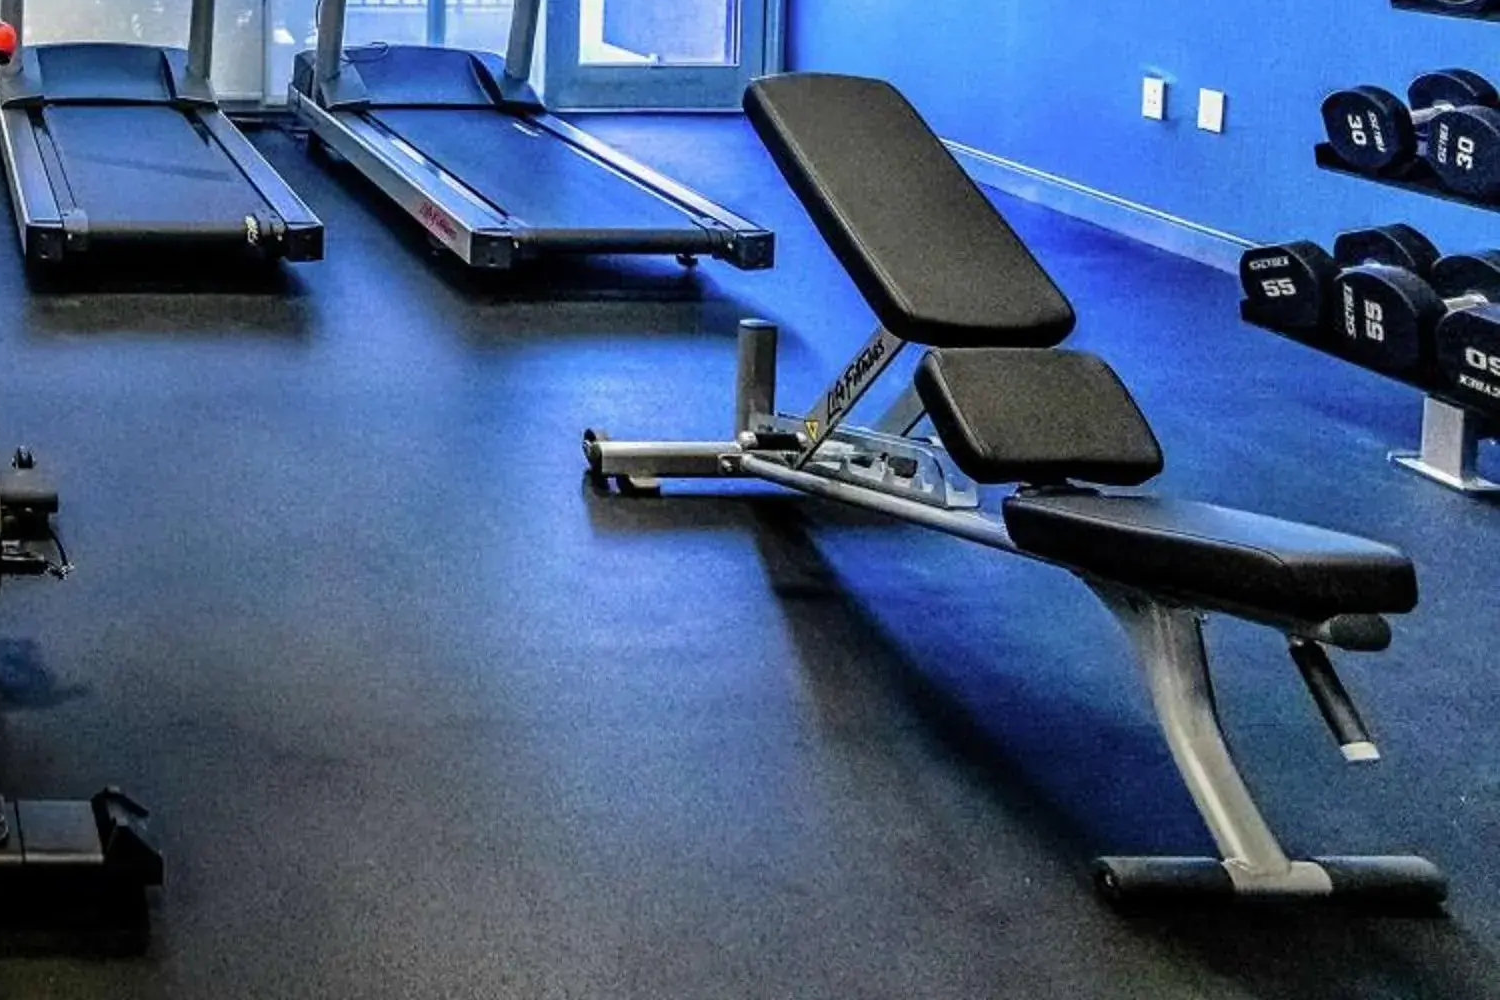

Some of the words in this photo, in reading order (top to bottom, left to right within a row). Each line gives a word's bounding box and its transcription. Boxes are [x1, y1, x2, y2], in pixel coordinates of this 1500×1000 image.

[1347, 113, 1367, 146] 30
[1456, 135, 1475, 170] 30
[1260, 277, 1297, 297] 55
[1363, 299, 1385, 342] 55
